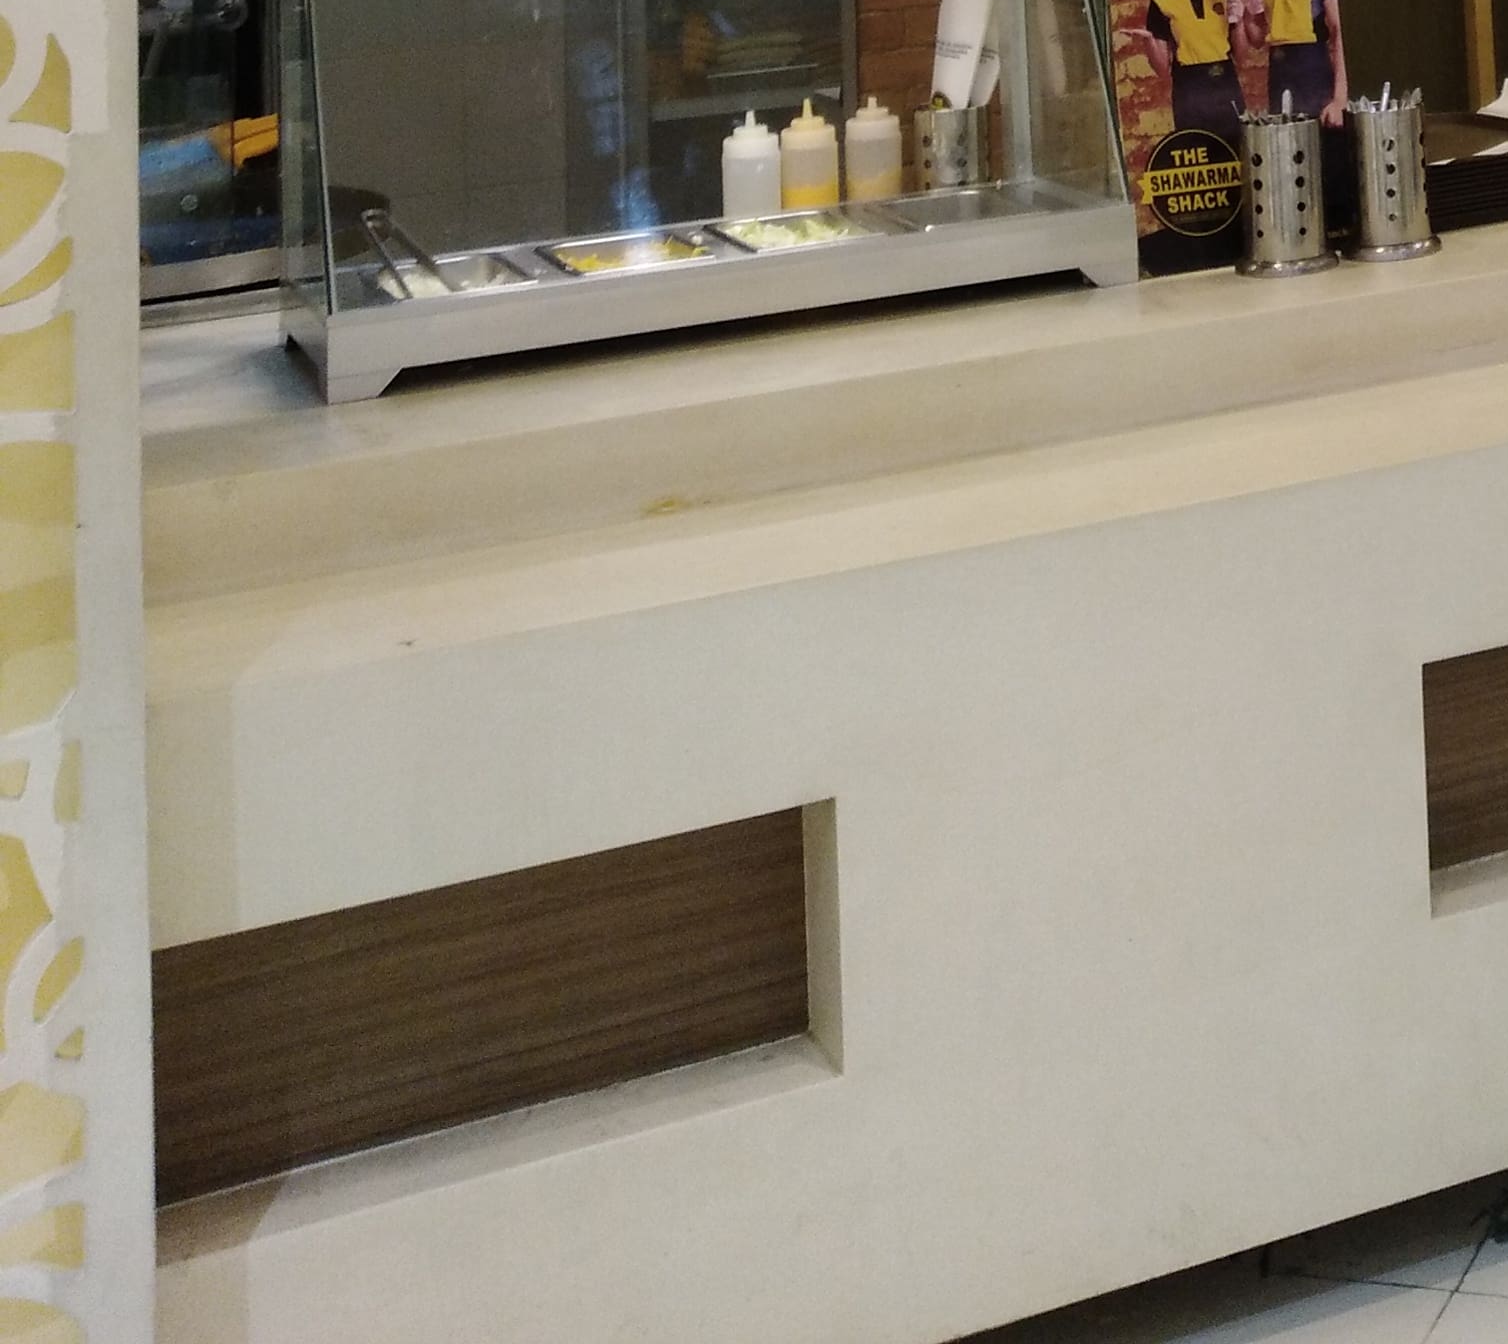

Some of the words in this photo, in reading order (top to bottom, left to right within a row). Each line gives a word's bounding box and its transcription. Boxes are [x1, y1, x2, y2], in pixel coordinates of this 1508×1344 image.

[1170, 147, 1209, 167] THE
[1150, 166, 1240, 192] SHAWARMA
[1168, 190, 1229, 214] SHACK
